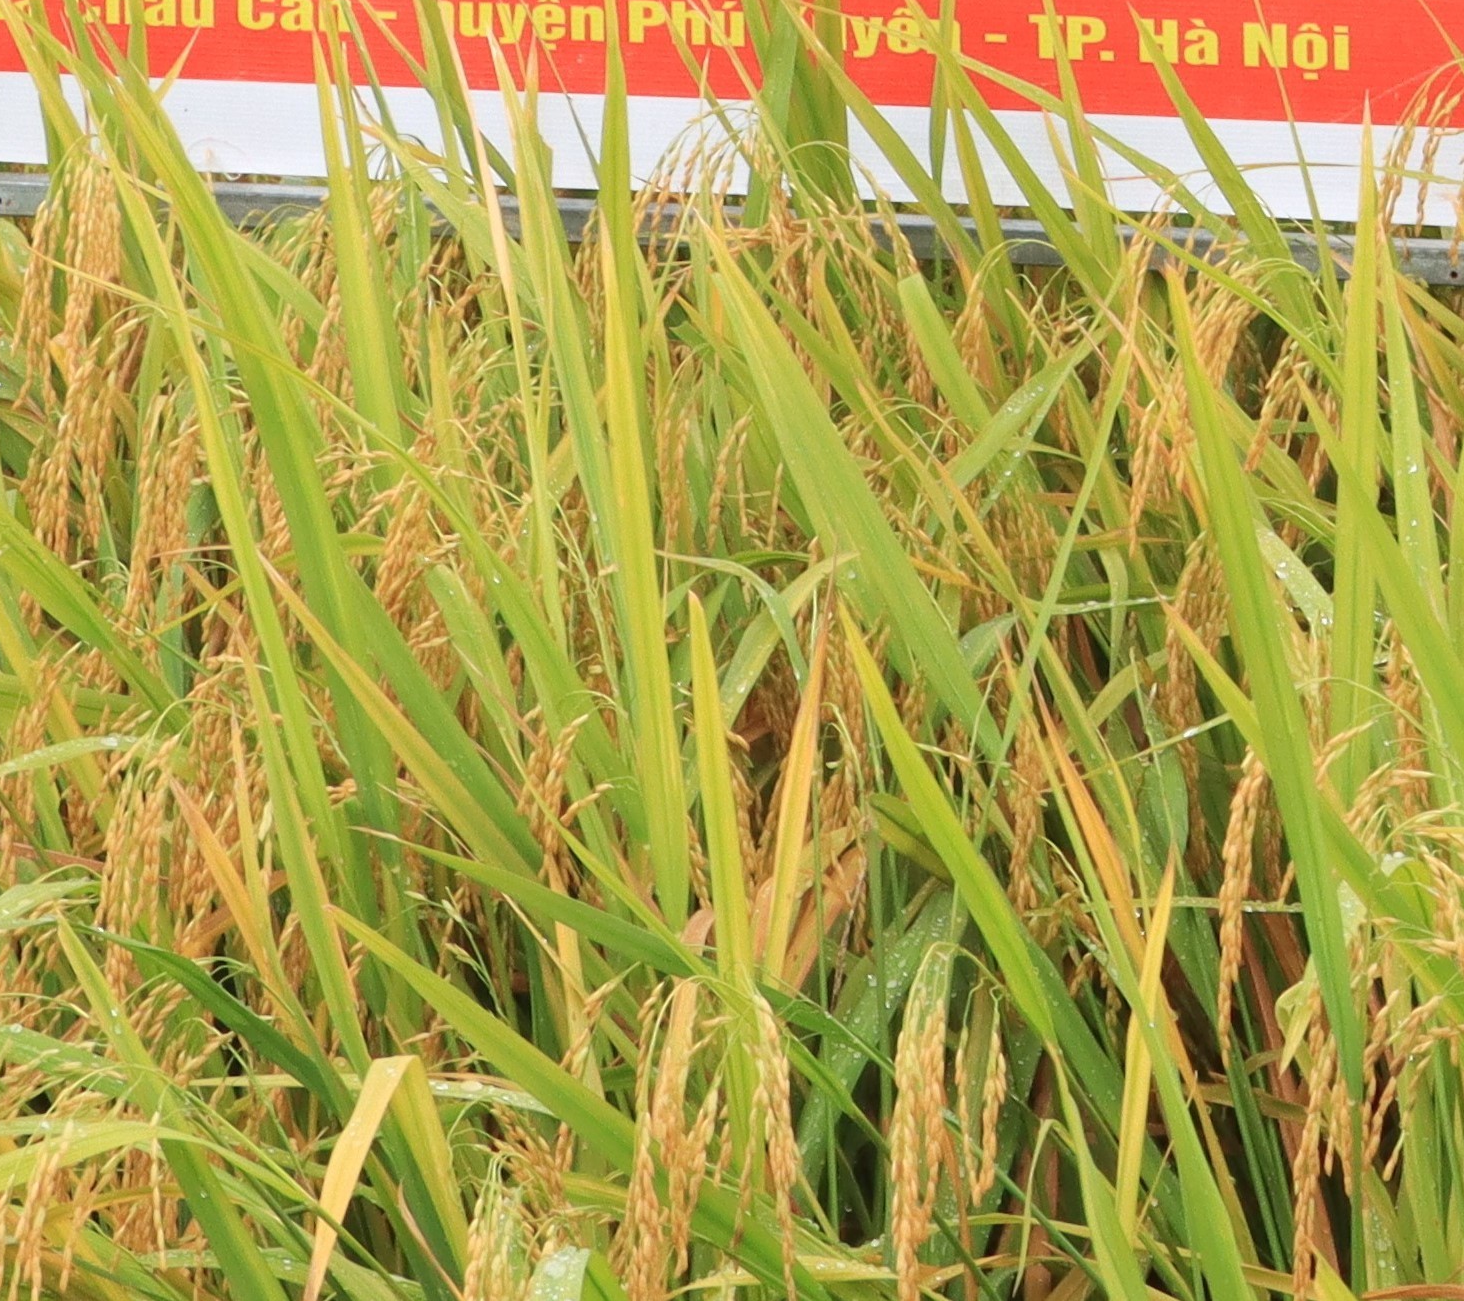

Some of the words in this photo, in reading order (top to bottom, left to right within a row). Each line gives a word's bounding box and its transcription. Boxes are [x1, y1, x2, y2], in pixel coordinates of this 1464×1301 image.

[628, 0, 746, 48] Phú
[1028, 13, 1115, 62] TP.
[1138, 17, 1220, 65] Hà
[1242, 22, 1350, 80] Nội
